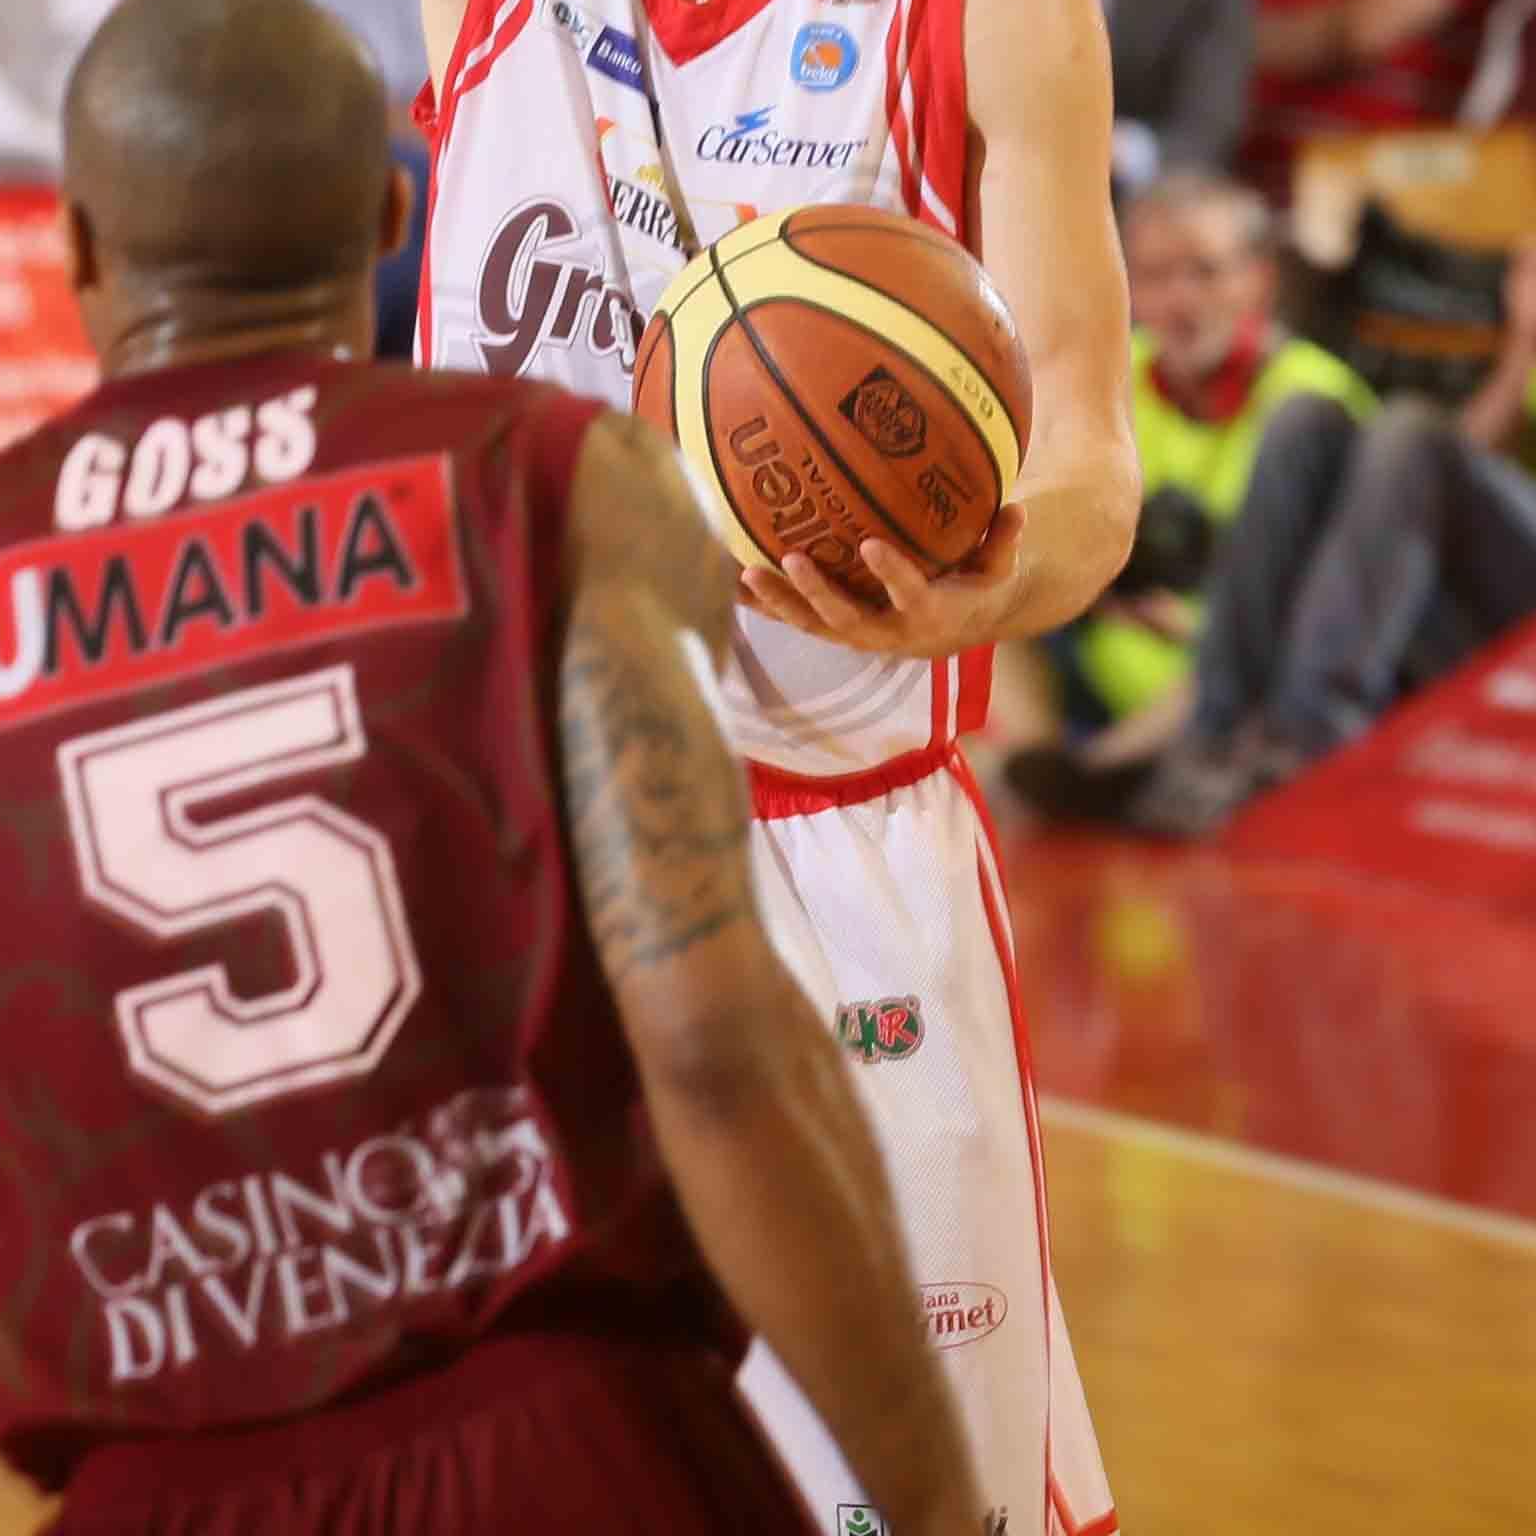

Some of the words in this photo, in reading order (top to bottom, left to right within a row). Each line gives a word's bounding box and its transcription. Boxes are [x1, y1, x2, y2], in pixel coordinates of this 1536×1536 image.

[695, 124, 864, 168] CarServer
[53, 385, 318, 532] GOSS
[729, 415, 857, 576] olten
[59, 663, 423, 1116] 5
[106, 1284, 198, 1382] DI
[201, 1177, 570, 1347] VENEZIA
